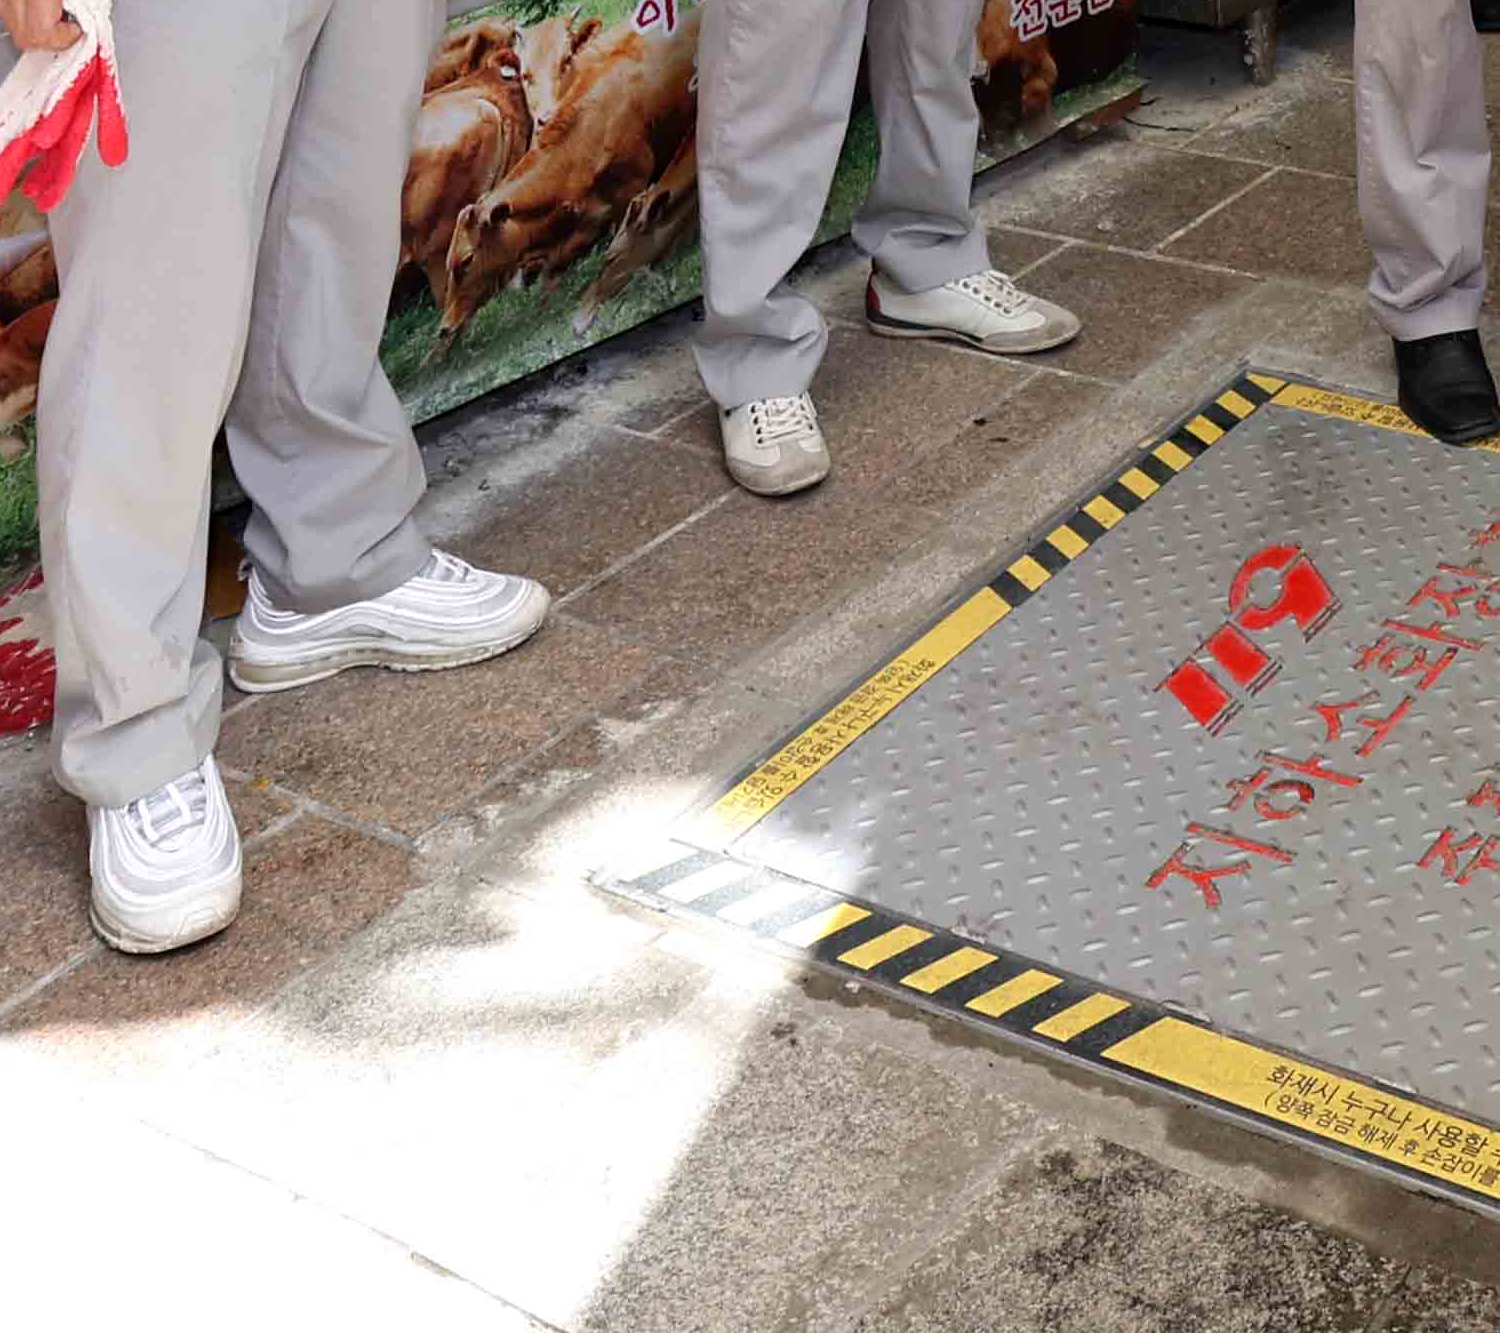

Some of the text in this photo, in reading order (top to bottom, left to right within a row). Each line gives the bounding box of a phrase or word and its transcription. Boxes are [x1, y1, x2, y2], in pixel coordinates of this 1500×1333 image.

[1266, 1064, 1340, 1105] 화재시
[1340, 1091, 1412, 1128] 누구나
[1415, 1117, 1489, 1156] 사용할
[1316, 1108, 1358, 1135] 잠금
[1357, 1122, 1398, 1152] 해제
[1397, 1136, 1420, 1158] 후
[1420, 1144, 1500, 1189] 손잡이를
